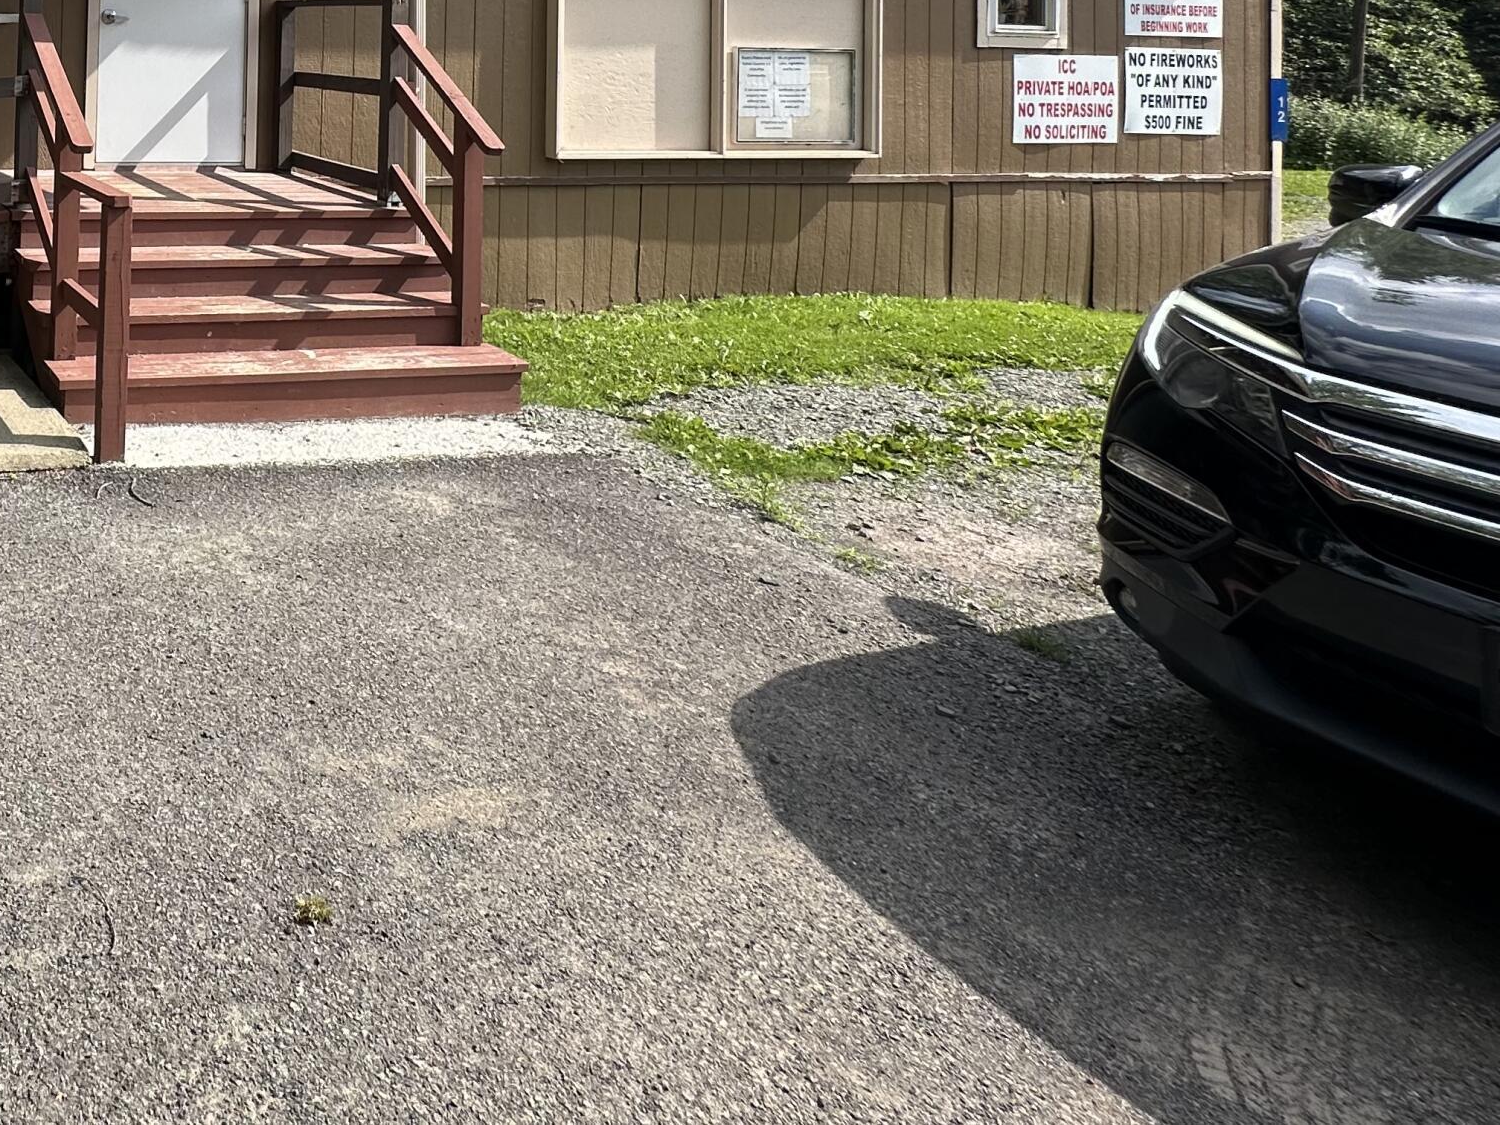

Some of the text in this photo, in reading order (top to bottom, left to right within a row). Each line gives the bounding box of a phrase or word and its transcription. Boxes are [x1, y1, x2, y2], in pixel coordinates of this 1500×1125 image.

[1130, 3, 1217, 17] OF INSURANCE BEFORE
[1141, 21, 1208, 33] BEGINNING WORK
[1058, 59, 1076, 74] ICC
[1129, 52, 1218, 69] NO FIREWORKS
[1017, 80, 1115, 96] PRIVATE HOA/POA
[1131, 73, 1218, 89] "OF ANY KIND"
[1140, 94, 1207, 109] PERMITTED
[1018, 103, 1113, 118] NO TRESPASSING
[1144, 115, 1203, 130] $500 FINE
[1024, 124, 1107, 139] NO SOLICITING
